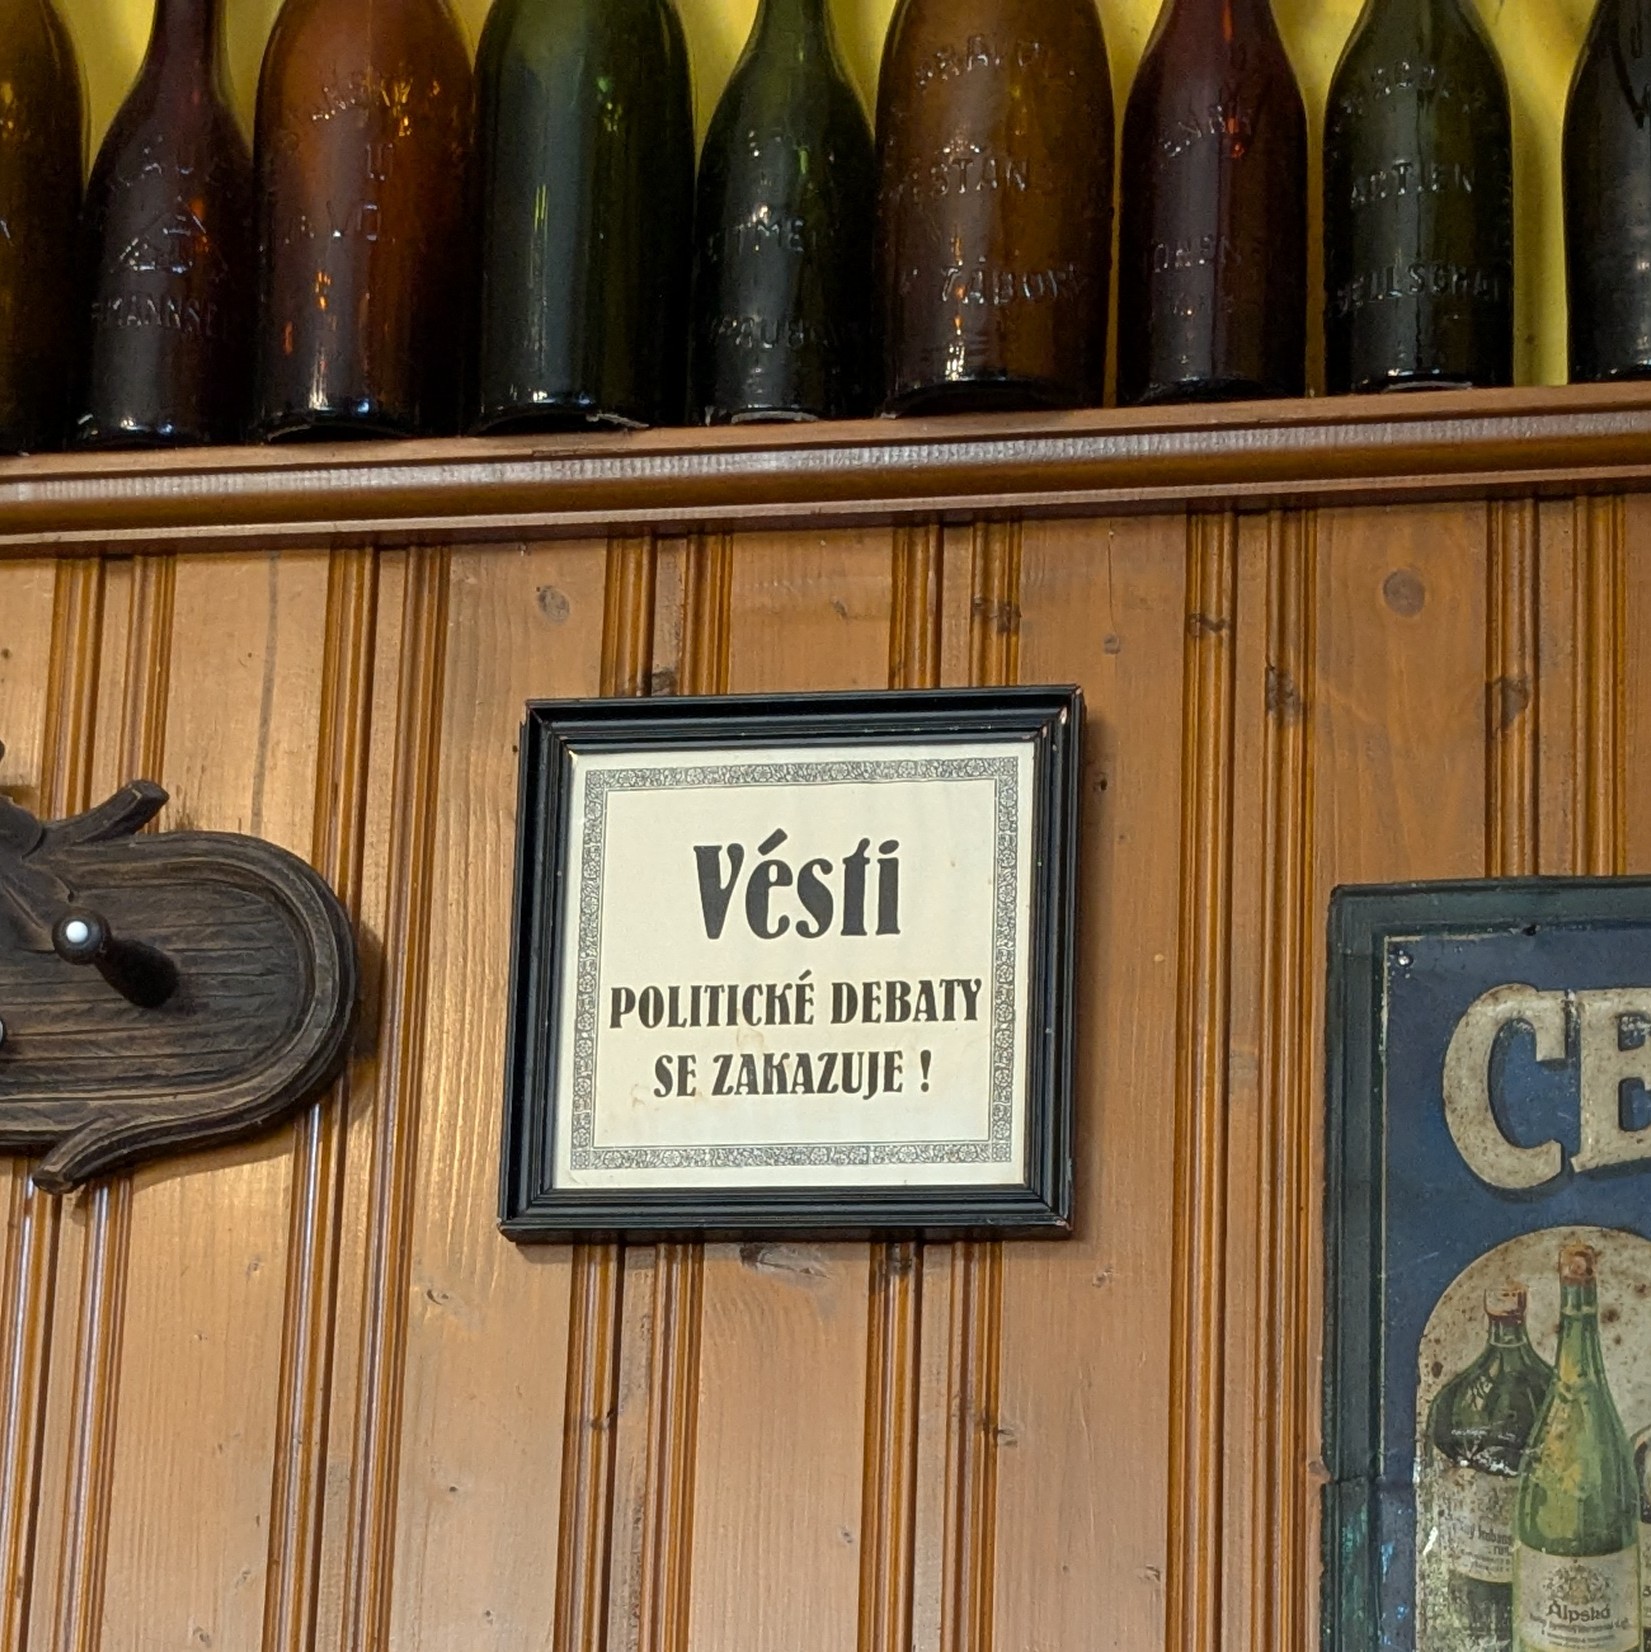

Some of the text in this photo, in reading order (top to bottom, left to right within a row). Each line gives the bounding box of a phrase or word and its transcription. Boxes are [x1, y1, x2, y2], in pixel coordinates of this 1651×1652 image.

[693, 828, 901, 940] Vésti
[609, 969, 982, 1029] POLITICKÉ DEBATY
[653, 1054, 697, 1098] SE
[711, 1050, 904, 1100] ZAKAZUJE
